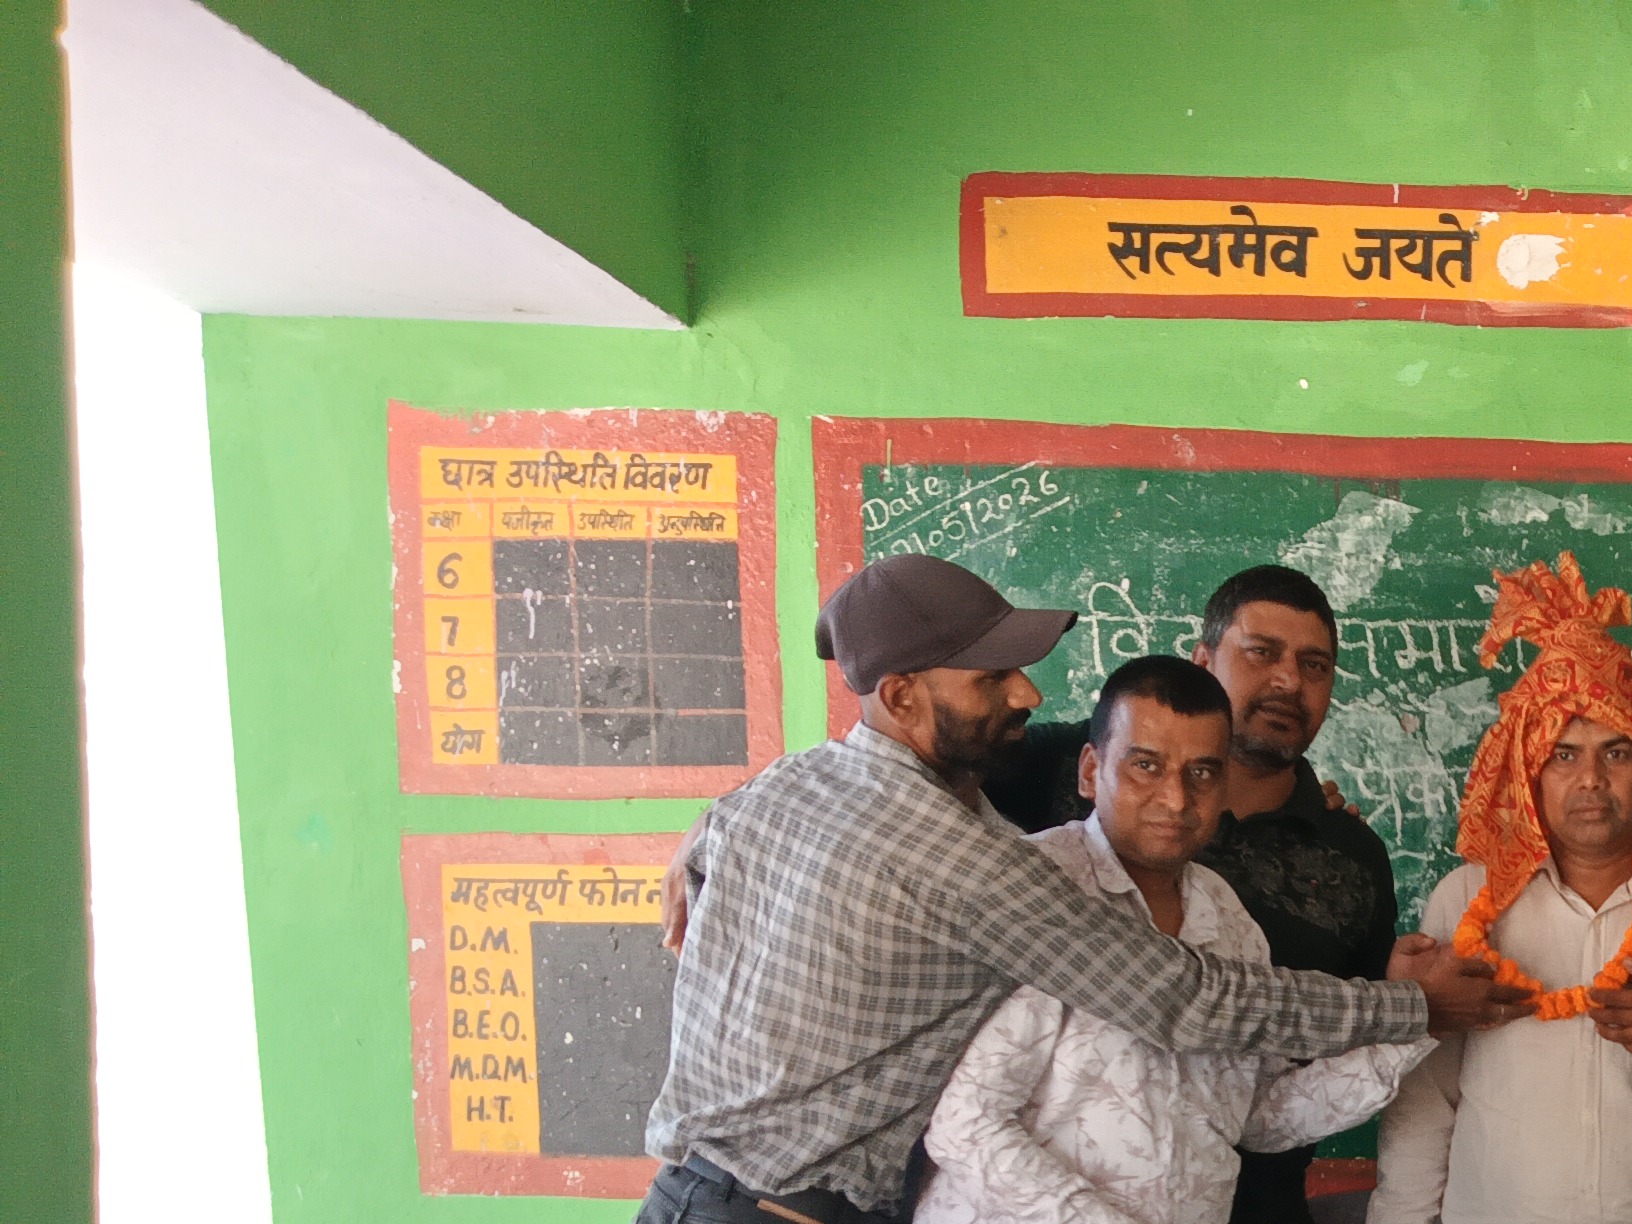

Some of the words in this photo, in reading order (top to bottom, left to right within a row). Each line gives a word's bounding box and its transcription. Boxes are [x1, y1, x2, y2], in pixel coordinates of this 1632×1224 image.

[1107, 204, 1318, 280] सत्यमेव
[1342, 213, 1480, 288] जयते
[506, 450, 618, 493] उपस्थिति
[623, 453, 713, 494] विवरण
[427, 510, 462, 528] कक्षा
[860, 476, 943, 531] Date
[437, 552, 463, 589] 6
[440, 616, 460, 646] 7
[445, 665, 468, 700] 8
[440, 723, 485, 755] योग
[450, 868, 573, 915] महत्वपूर्ण
[579, 867, 647, 907] फोन
[449, 924, 519, 955] D.M.
[449, 965, 526, 998] B.S.A.
[452, 1009, 528, 1042] B.E.O.
[450, 1054, 535, 1084] M.D.M.
[467, 1095, 514, 1123] H.T.
